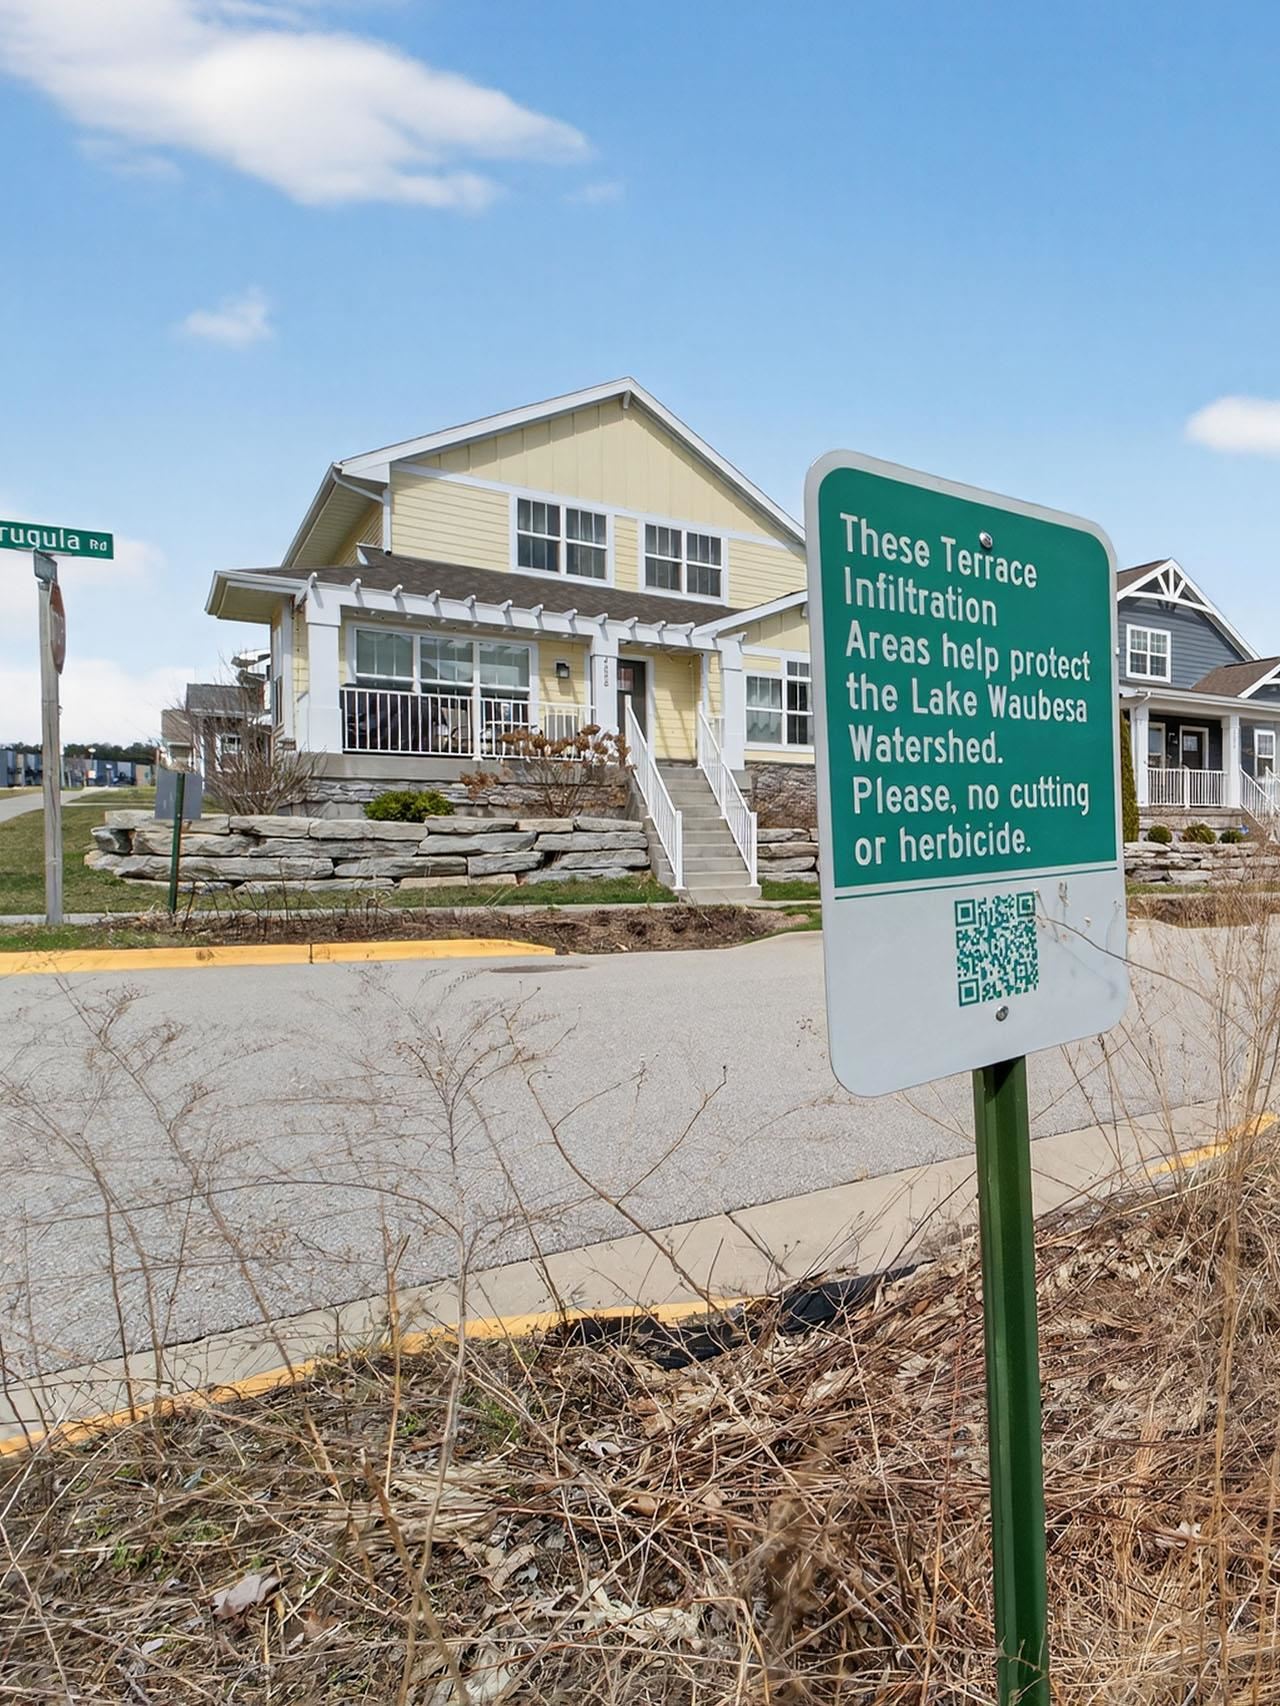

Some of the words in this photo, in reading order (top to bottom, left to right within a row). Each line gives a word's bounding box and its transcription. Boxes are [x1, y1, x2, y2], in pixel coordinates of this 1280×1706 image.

[89, 538, 108, 552] Rd
[840, 512, 930, 568] These
[940, 535, 1038, 589] Terrace
[844, 566, 998, 627] Infiltration
[845, 619, 931, 665] Areas
[942, 632, 1000, 680] help
[1010, 647, 1091, 682] protect
[846, 672, 899, 712] the
[911, 677, 978, 716] Lake
[987, 684, 1088, 723] Waubesa
[848, 723, 1004, 764] Watershed.
[852, 776, 958, 815] Please,
[967, 782, 1000, 811] no
[1009, 775, 1090, 817] cutting
[854, 836, 887, 866] or
[899, 821, 1032, 863] herbicide.
